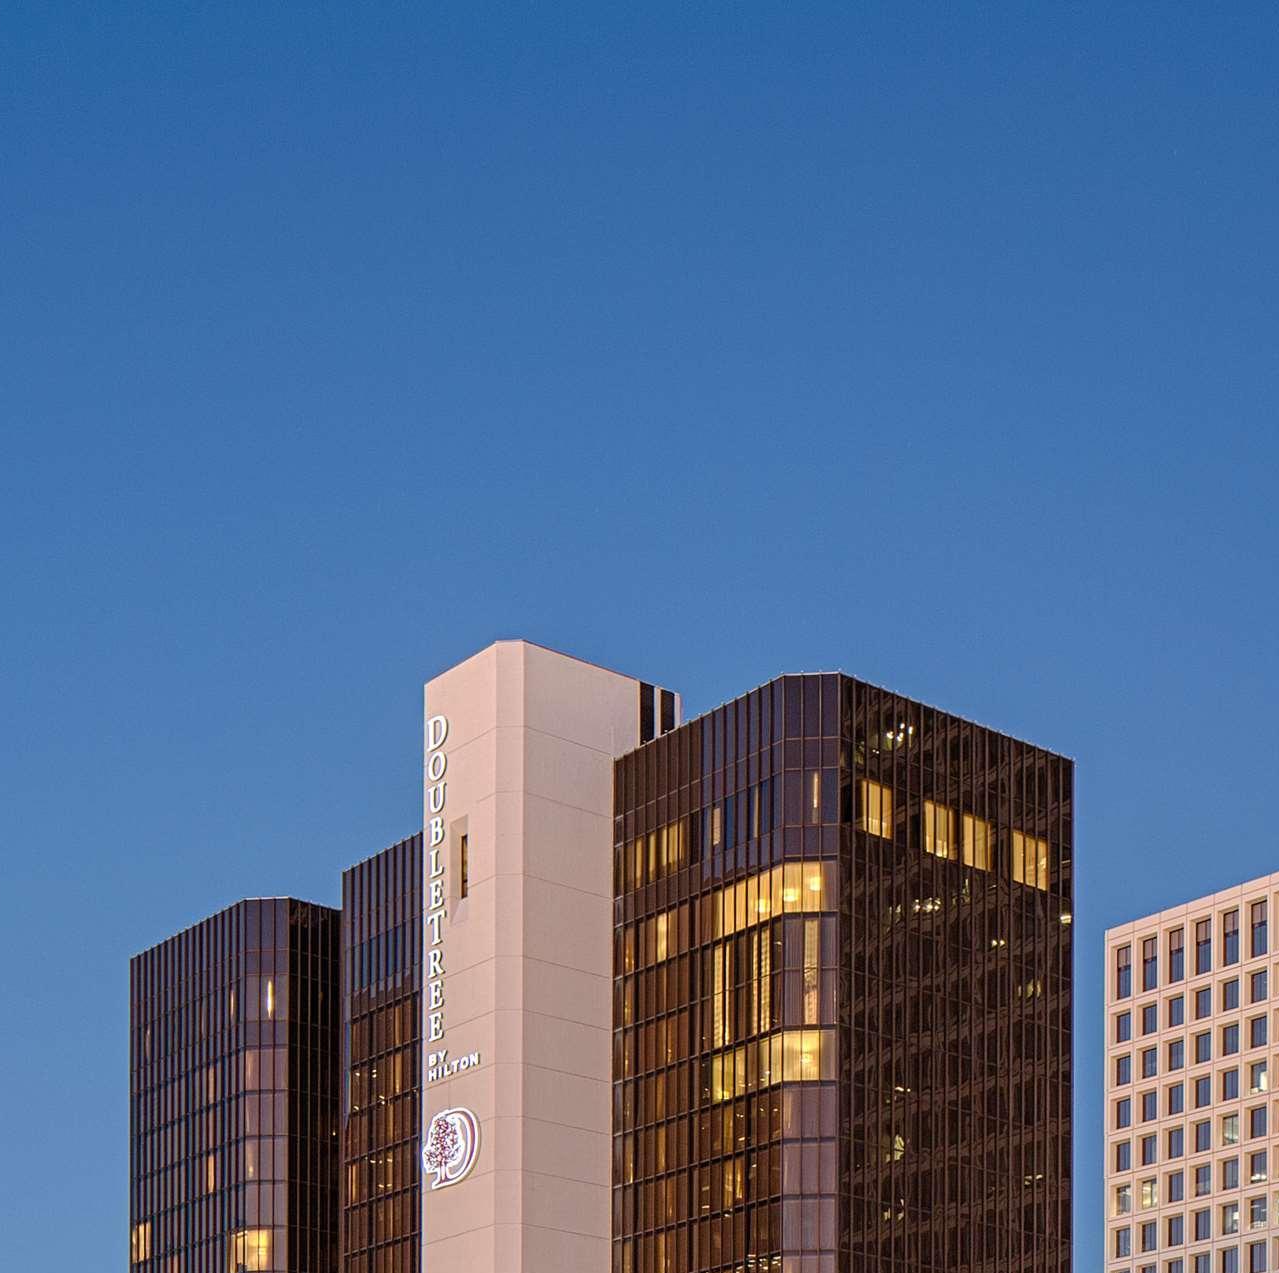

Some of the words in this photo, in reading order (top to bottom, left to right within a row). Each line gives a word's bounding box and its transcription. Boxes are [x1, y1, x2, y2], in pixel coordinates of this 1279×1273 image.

[425, 715, 449, 1043] DOUBLETREE
[428, 1050, 448, 1067] BY
[428, 1052, 480, 1082] HILTON
